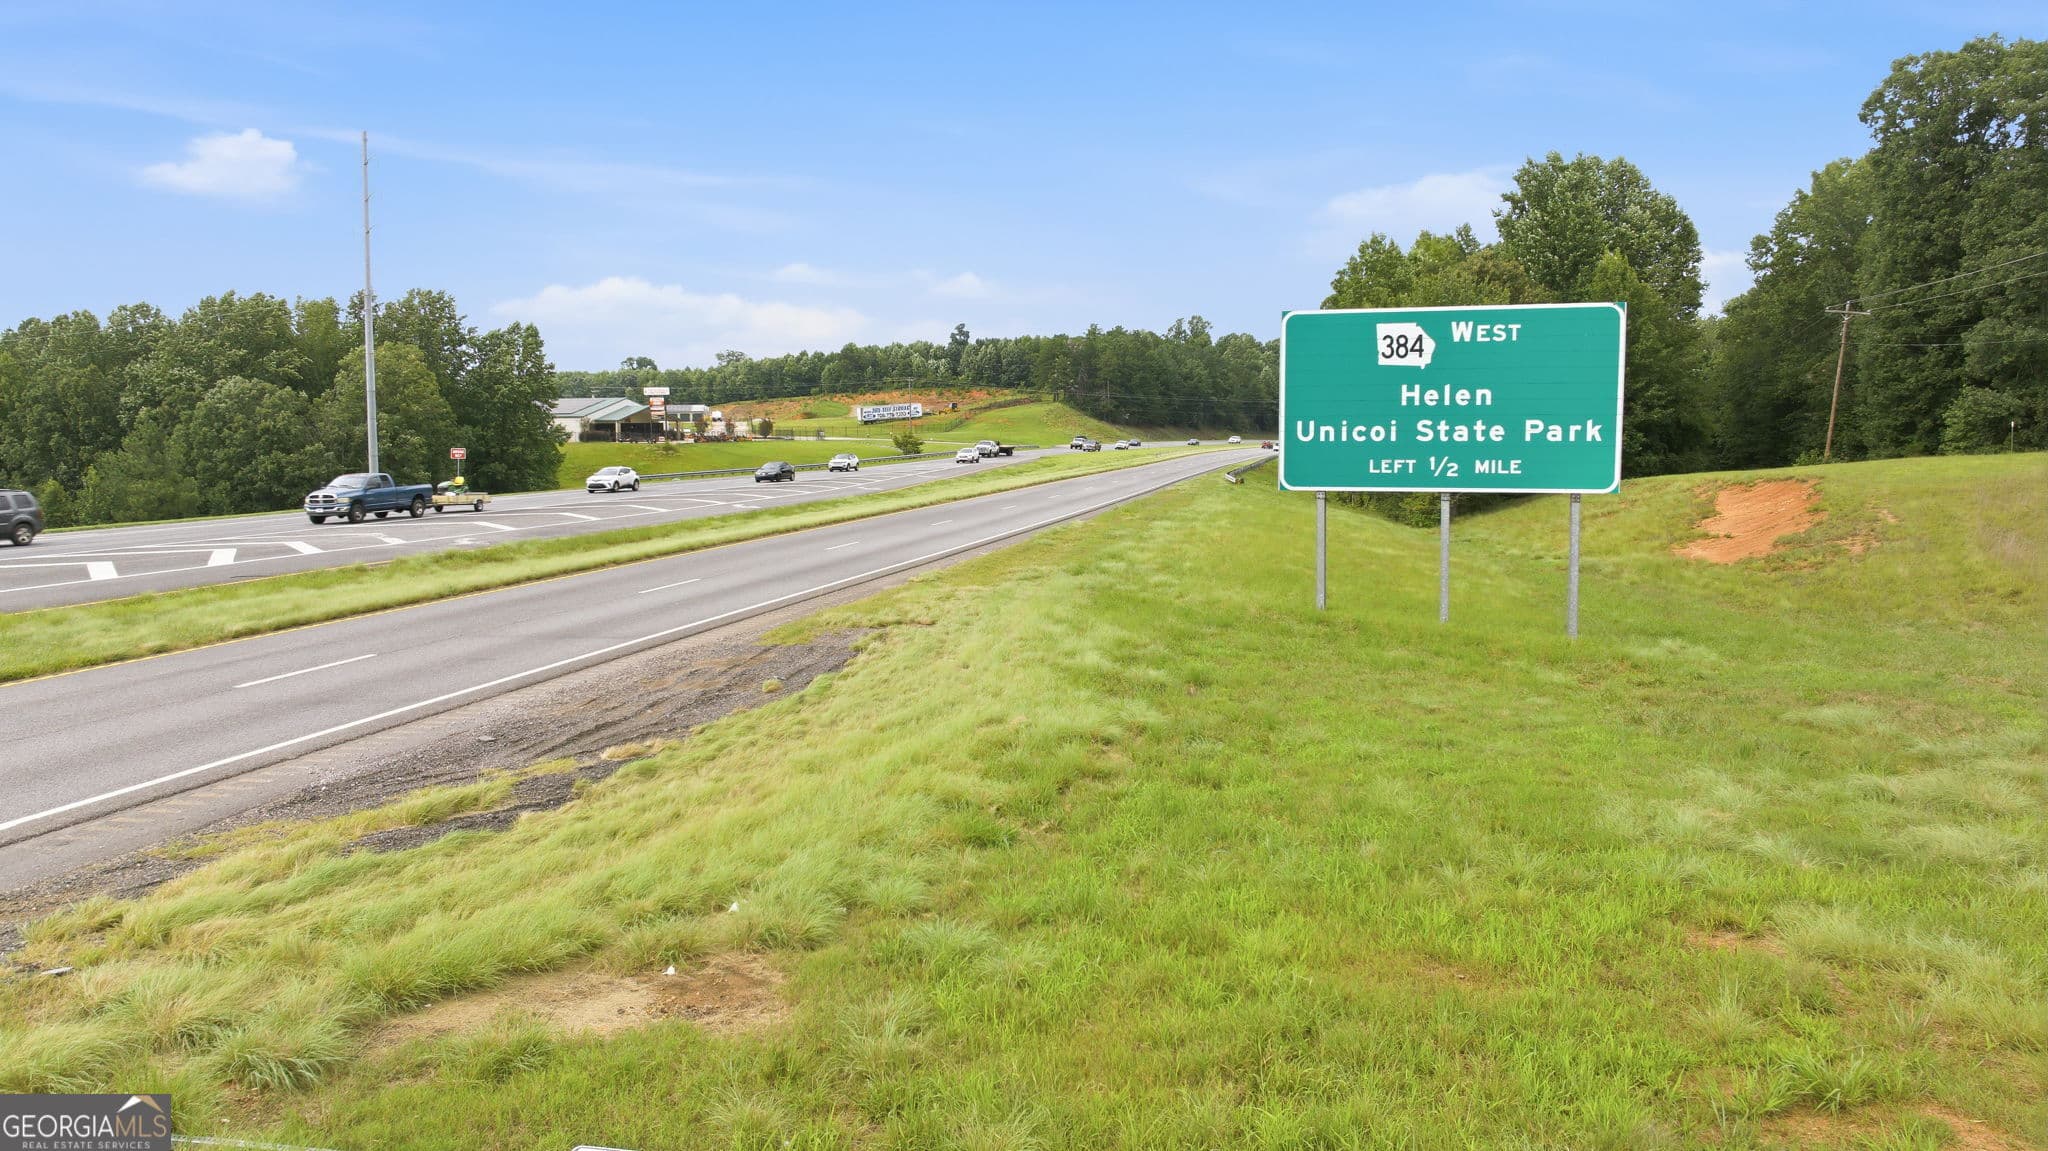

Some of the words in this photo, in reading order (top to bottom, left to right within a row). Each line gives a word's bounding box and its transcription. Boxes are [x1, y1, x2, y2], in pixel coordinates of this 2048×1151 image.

[1381, 334, 1425, 359] 384
[1400, 383, 1493, 407] Helen
[1296, 419, 1398, 442] Unicoi
[1415, 419, 1506, 442] State
[1525, 419, 1603, 442] Park
[1369, 459, 1417, 474] LEFT
[1474, 459, 1522, 474] MILE
